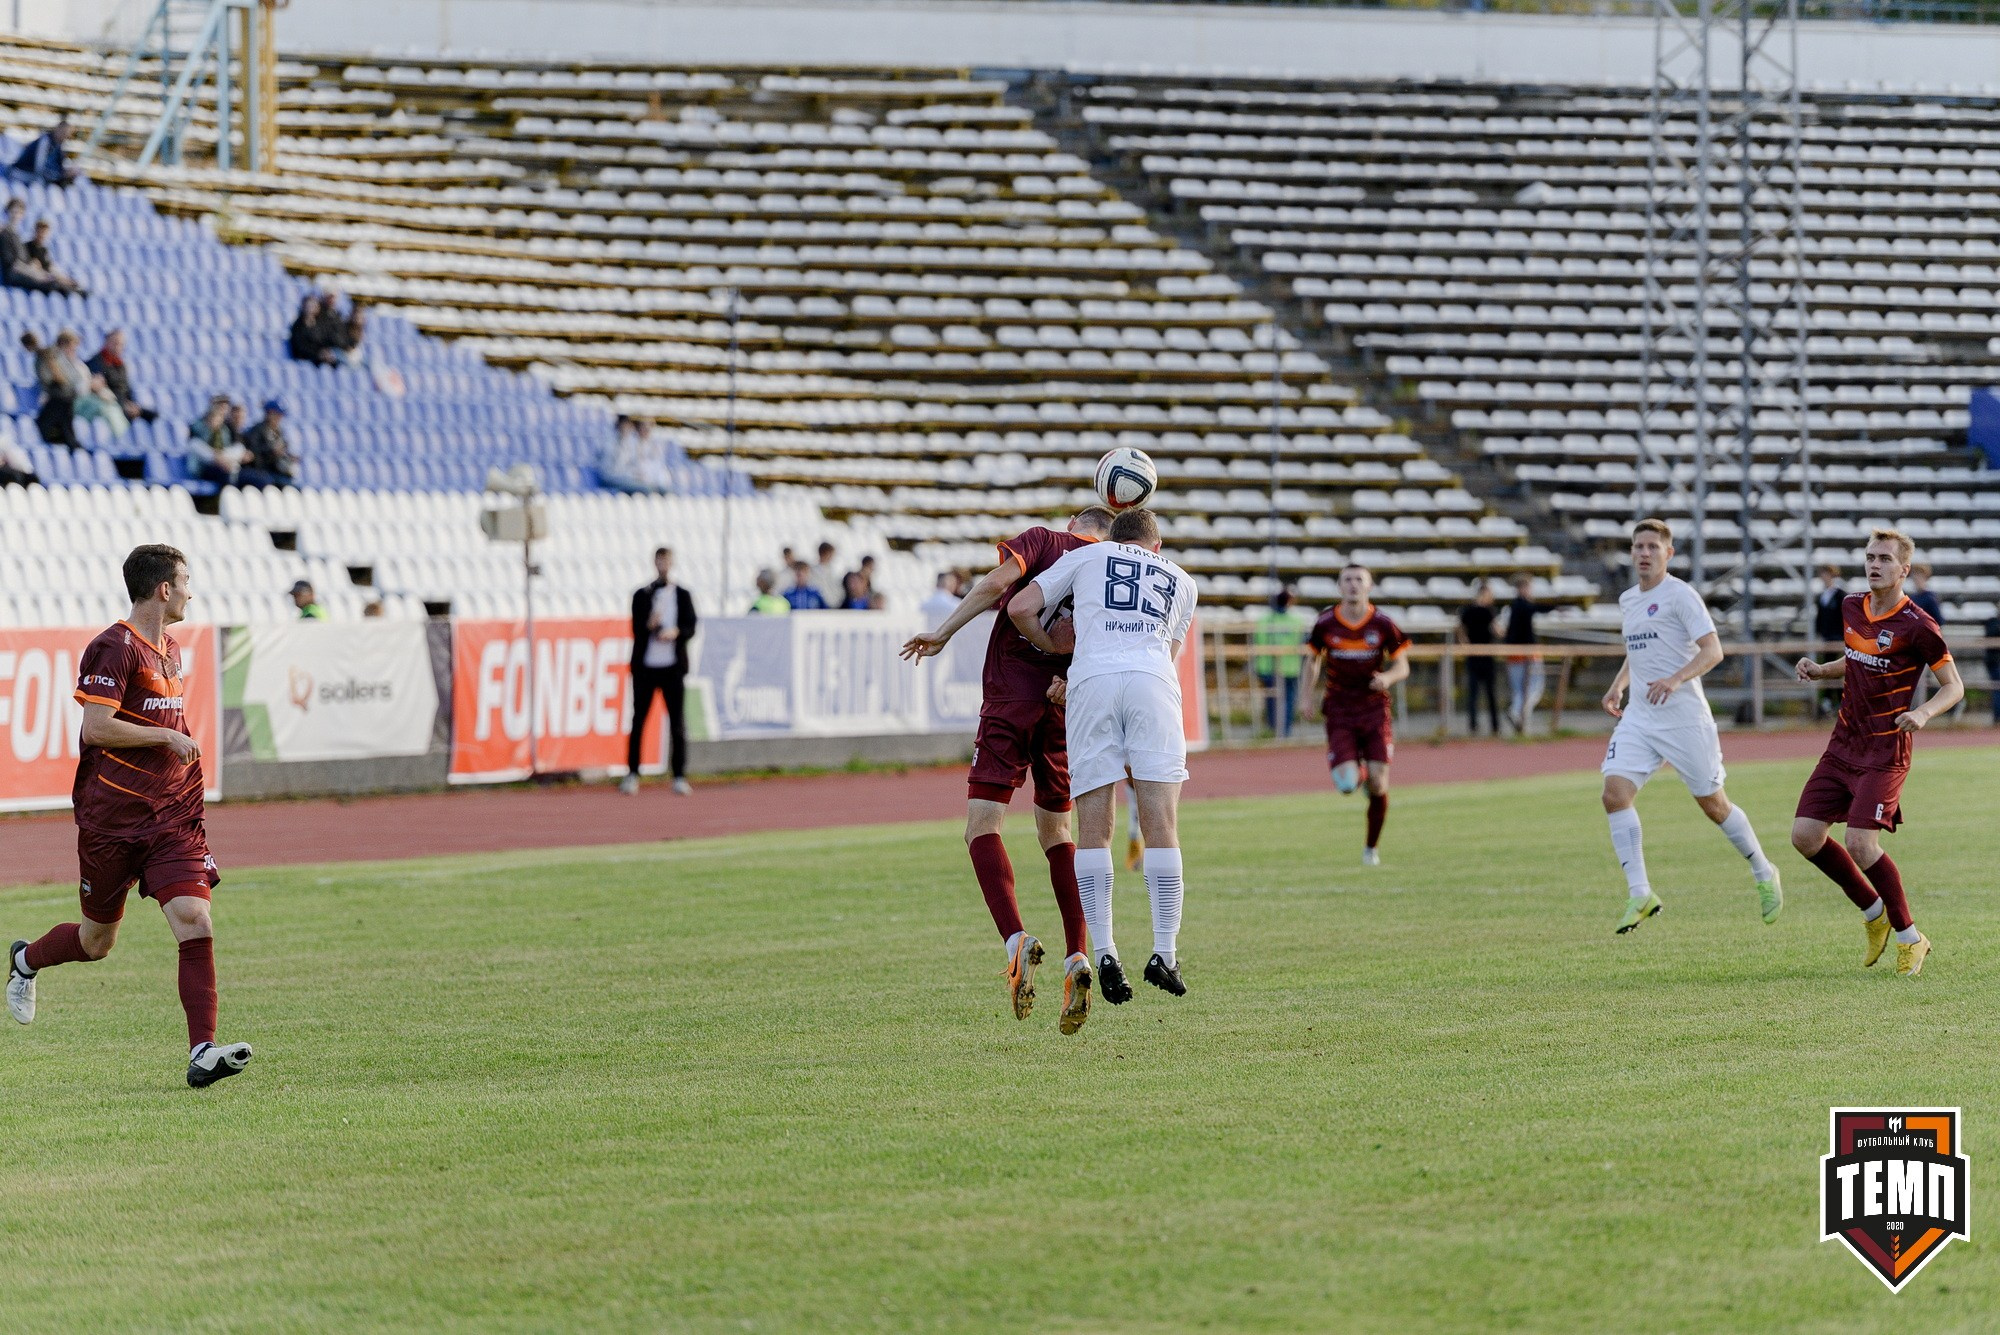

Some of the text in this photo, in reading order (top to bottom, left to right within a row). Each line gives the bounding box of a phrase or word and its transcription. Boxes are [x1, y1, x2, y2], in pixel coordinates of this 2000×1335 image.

[1105, 556, 1177, 624] 83
[1105, 620, 1144, 633] НИЖНИЙ
[95, 675, 116, 687] ПСБ
[1875, 803, 1884, 820] 6
